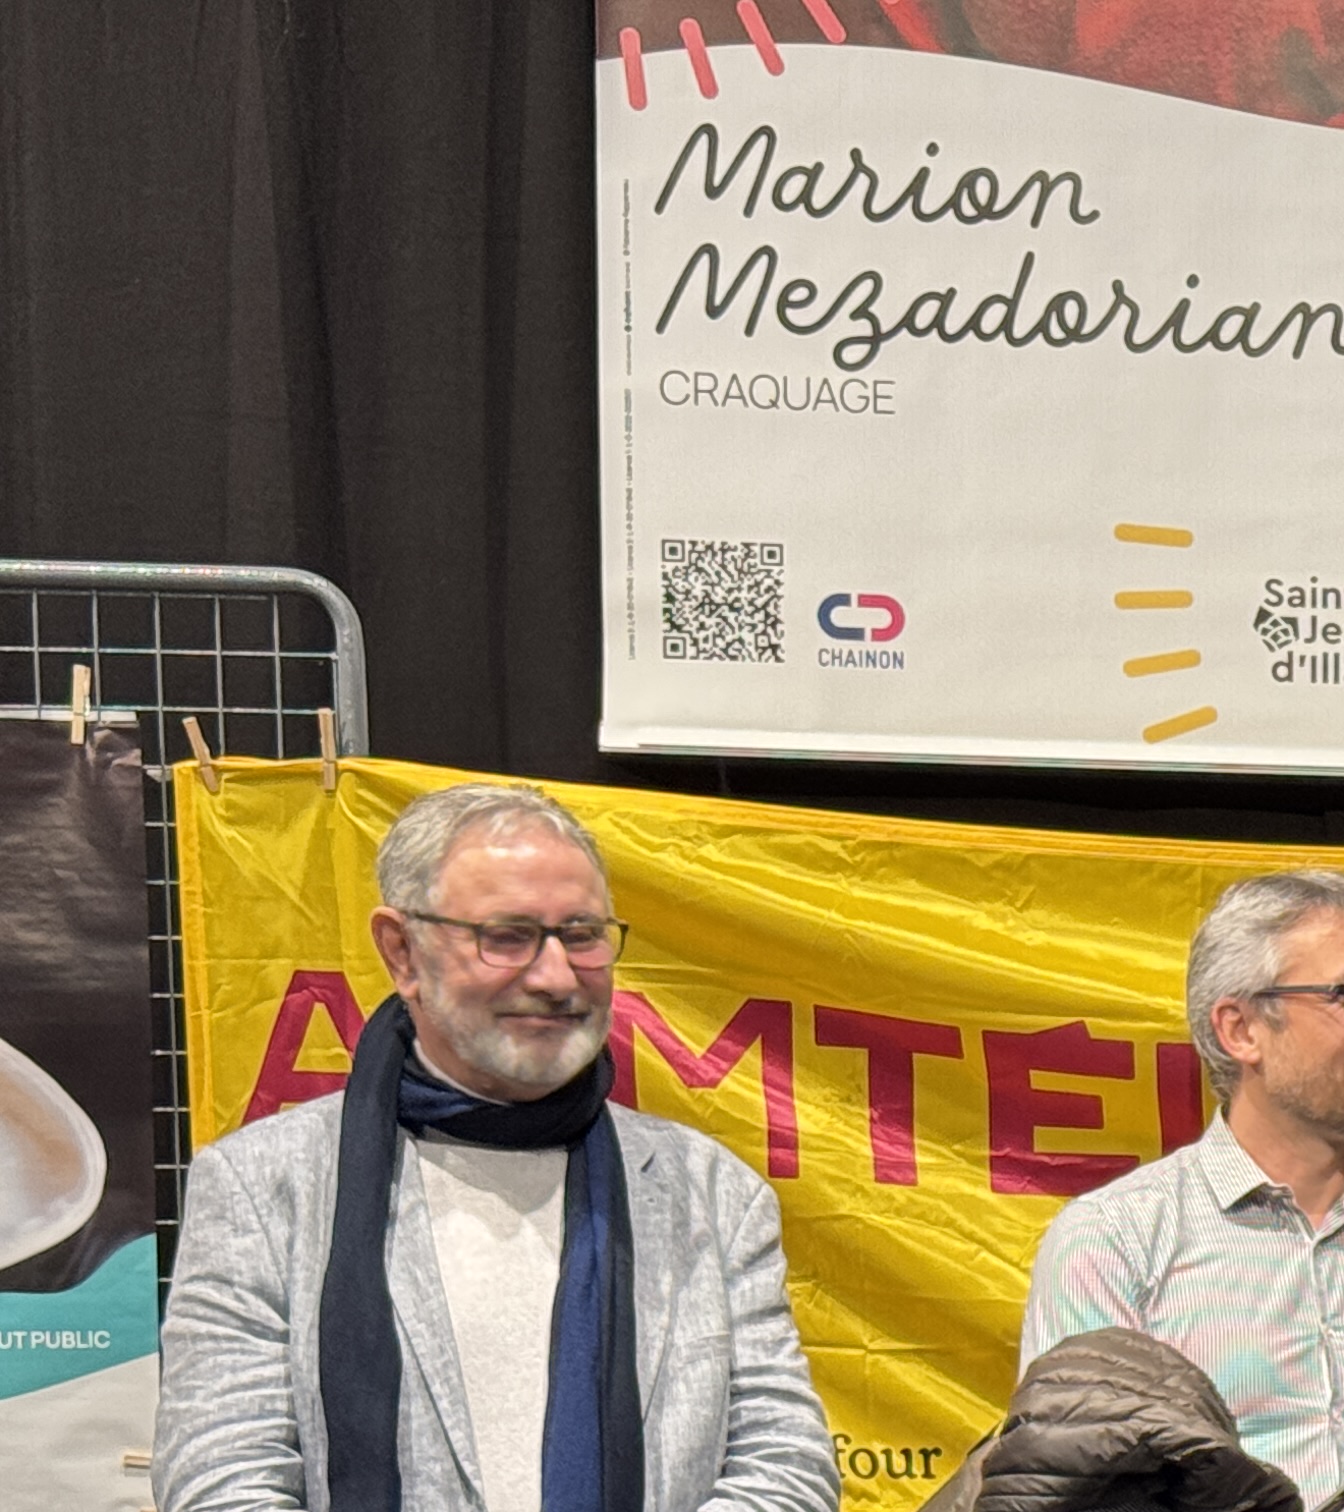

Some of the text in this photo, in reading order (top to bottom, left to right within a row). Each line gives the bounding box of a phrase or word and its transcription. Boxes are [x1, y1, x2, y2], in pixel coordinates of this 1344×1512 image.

[655, 123, 1100, 228] Marion
[659, 370, 896, 414] CRAQUAGE
[817, 648, 904, 670] CHAINON
[31, 1330, 111, 1349] PUBLIC
